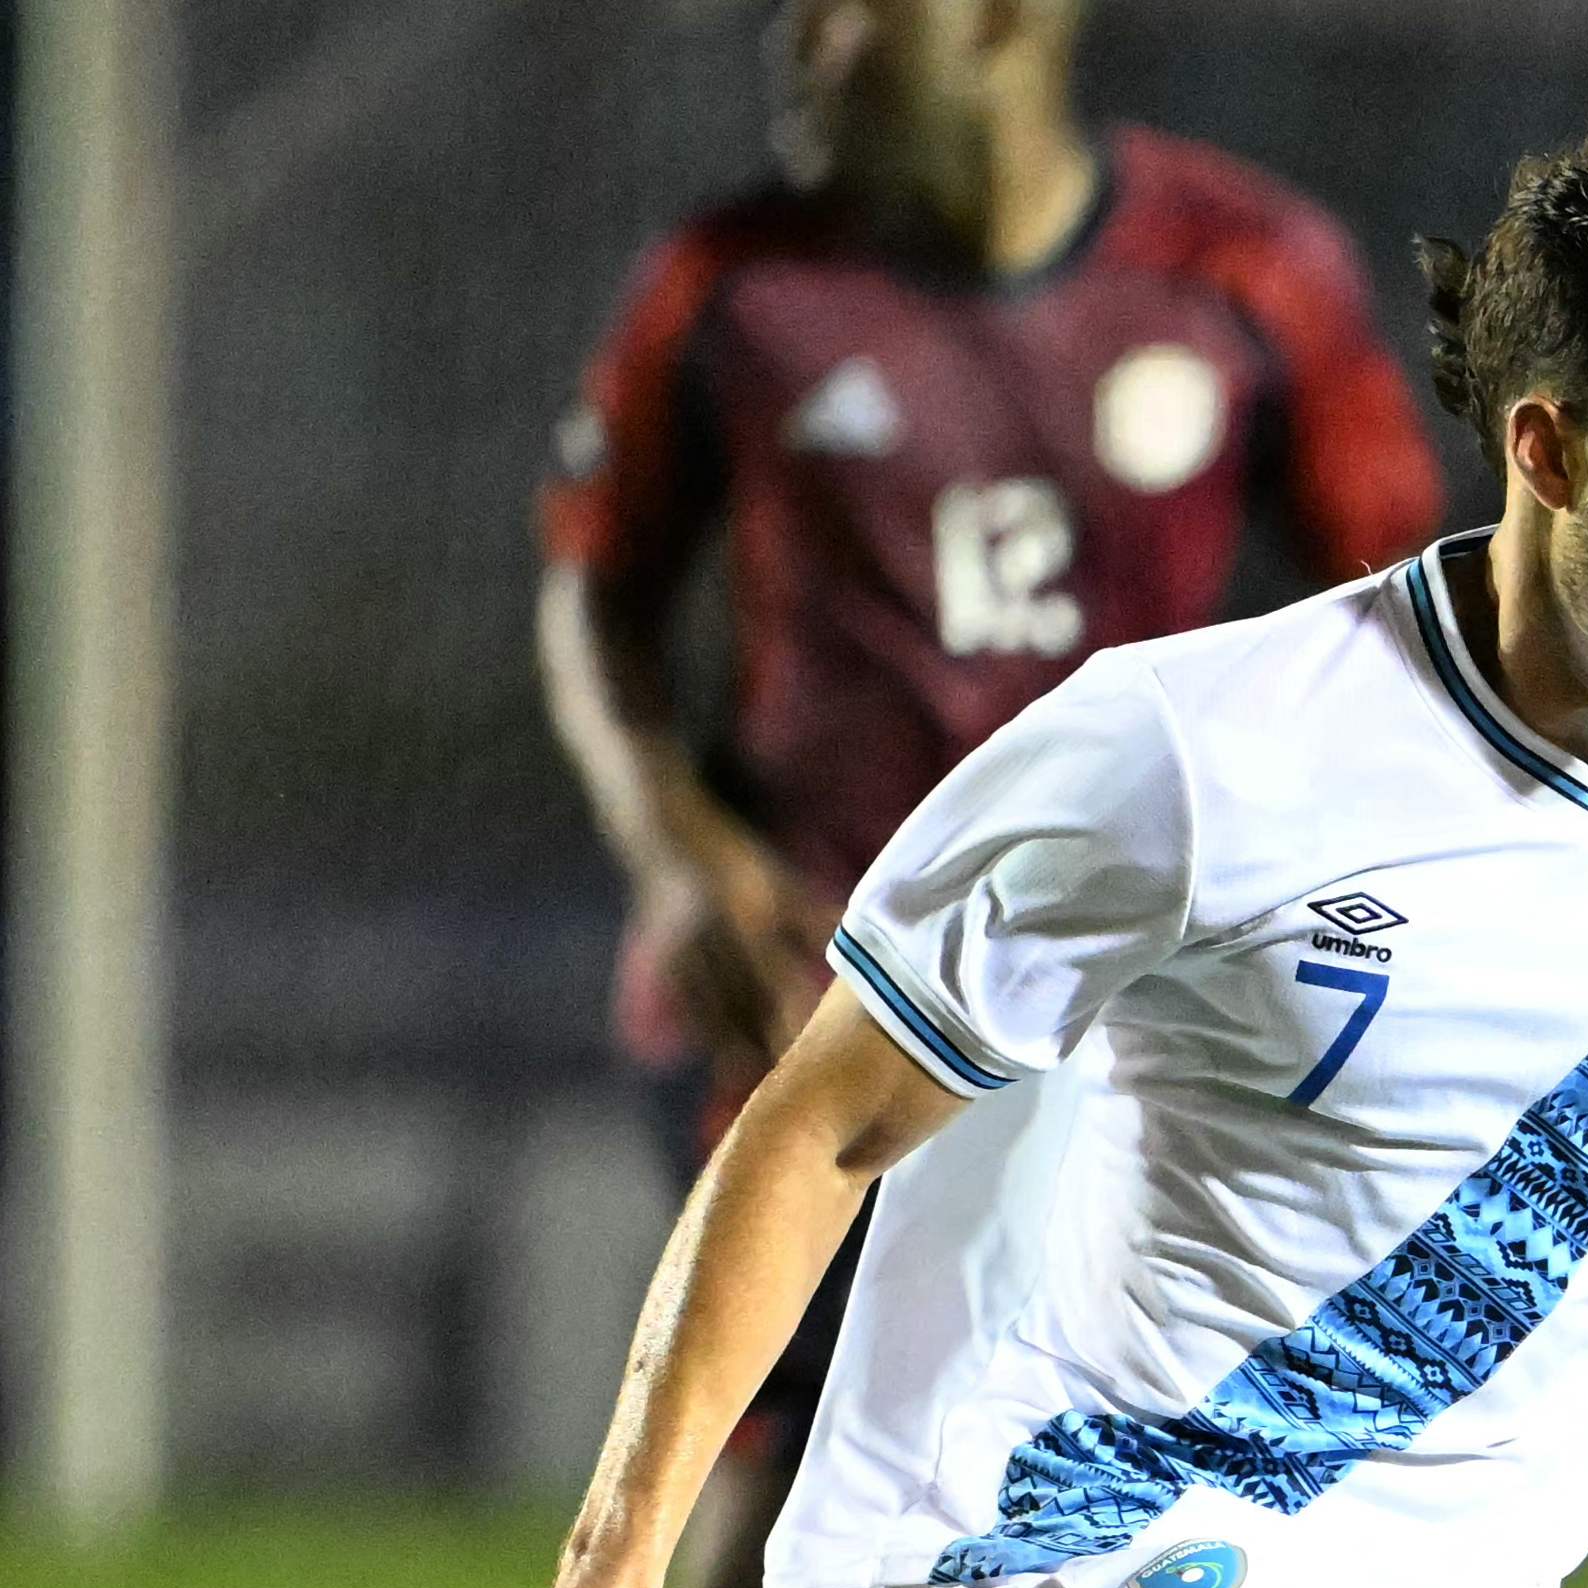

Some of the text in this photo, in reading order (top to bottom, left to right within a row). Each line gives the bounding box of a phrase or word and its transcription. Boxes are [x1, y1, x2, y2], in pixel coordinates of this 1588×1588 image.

[930, 475, 1085, 657] 12
[1311, 932, 1392, 963] umbro
[1286, 960, 1390, 1112] 7
